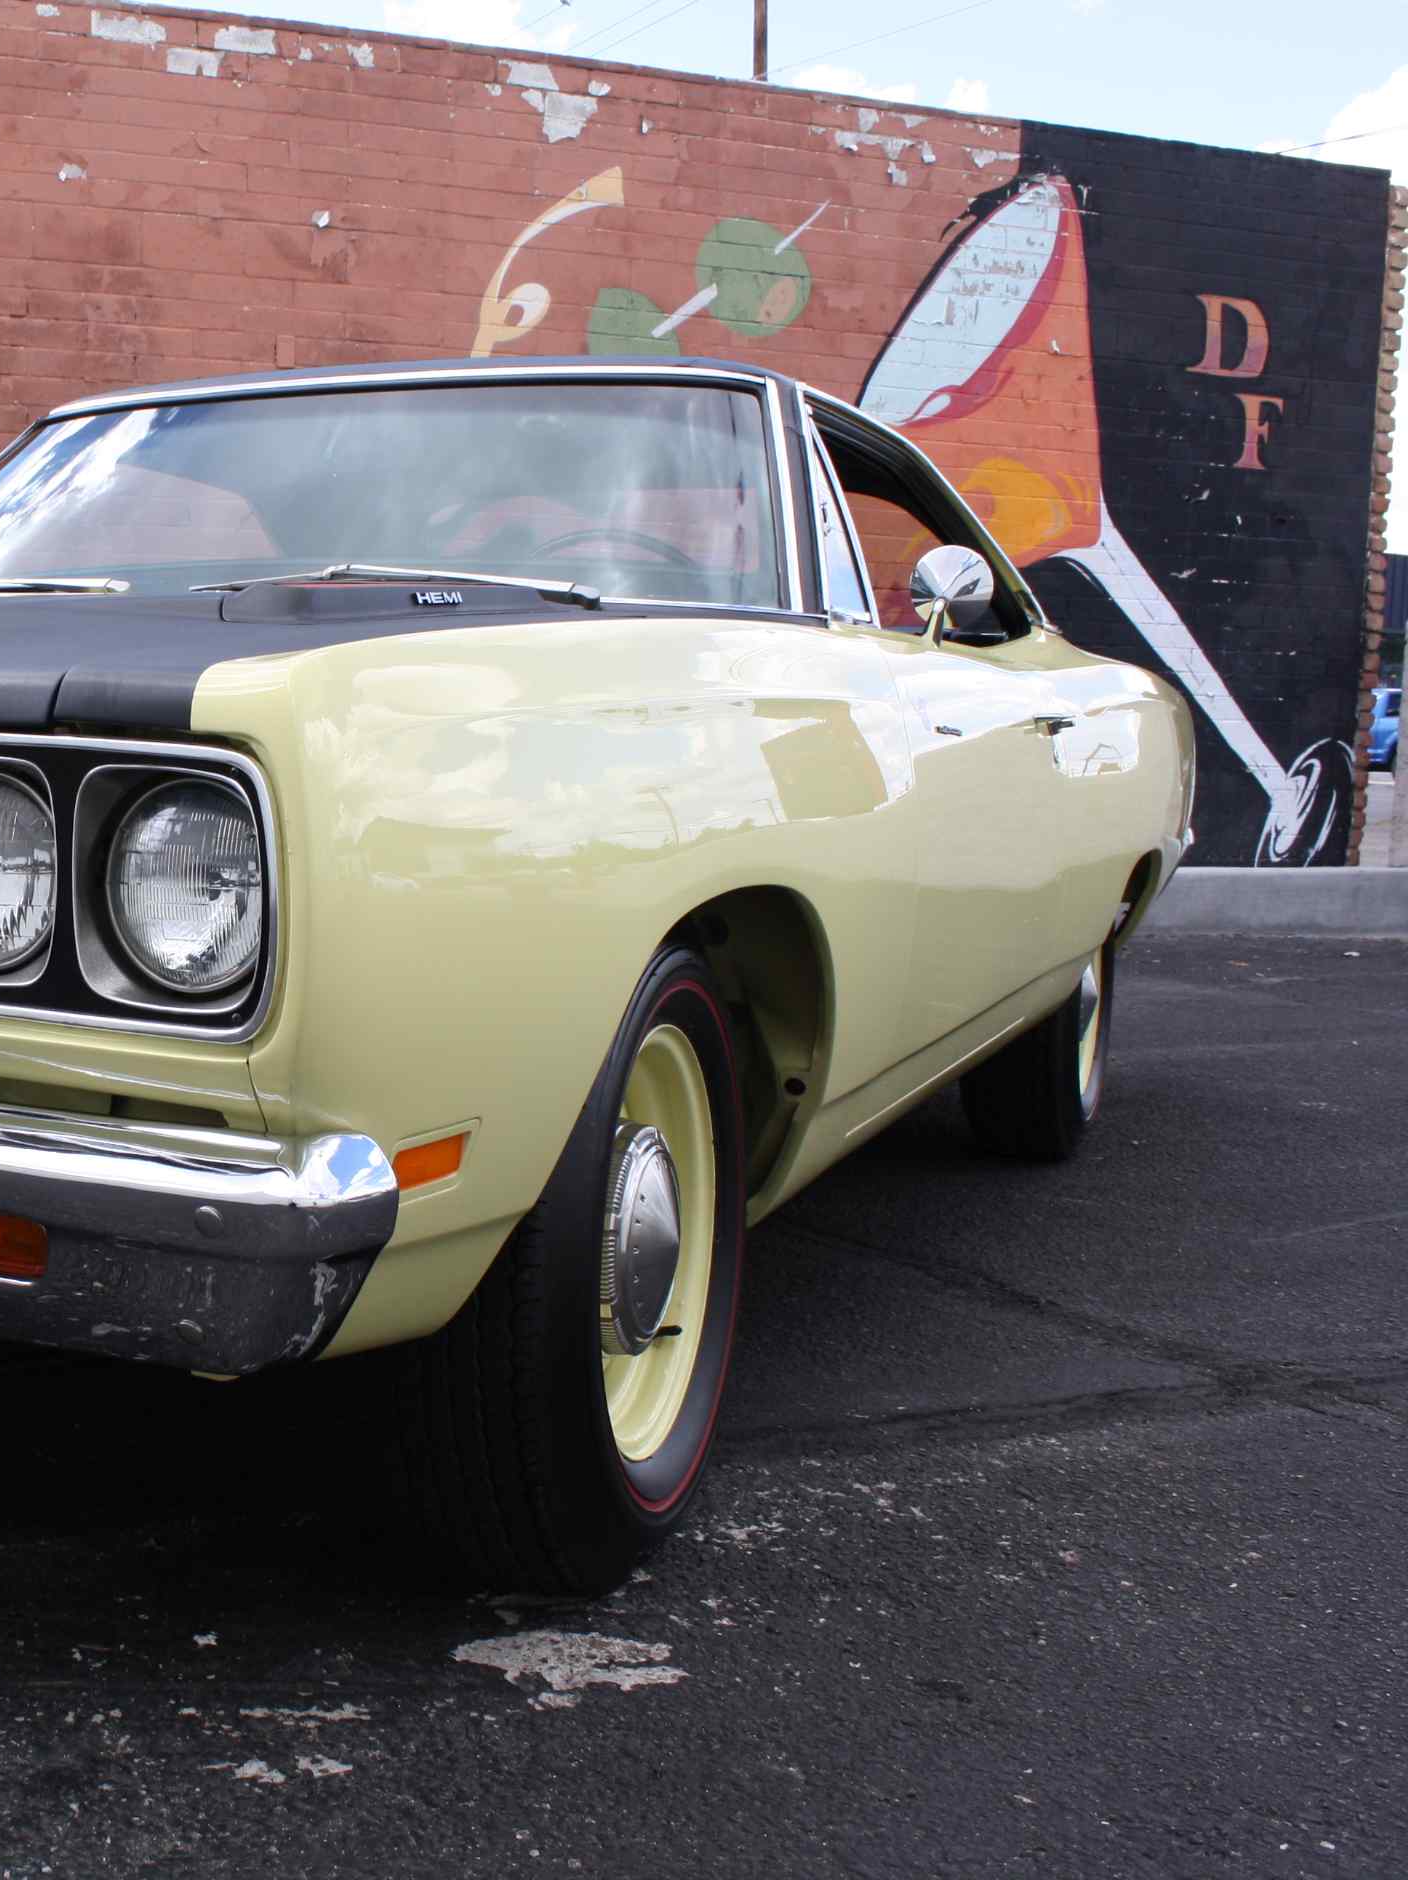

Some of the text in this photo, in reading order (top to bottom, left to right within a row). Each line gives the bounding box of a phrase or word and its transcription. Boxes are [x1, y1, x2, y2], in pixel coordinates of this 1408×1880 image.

[1185, 293, 1269, 378] D
[1233, 392, 1284, 470] F
[415, 591, 464, 605] HEMI
